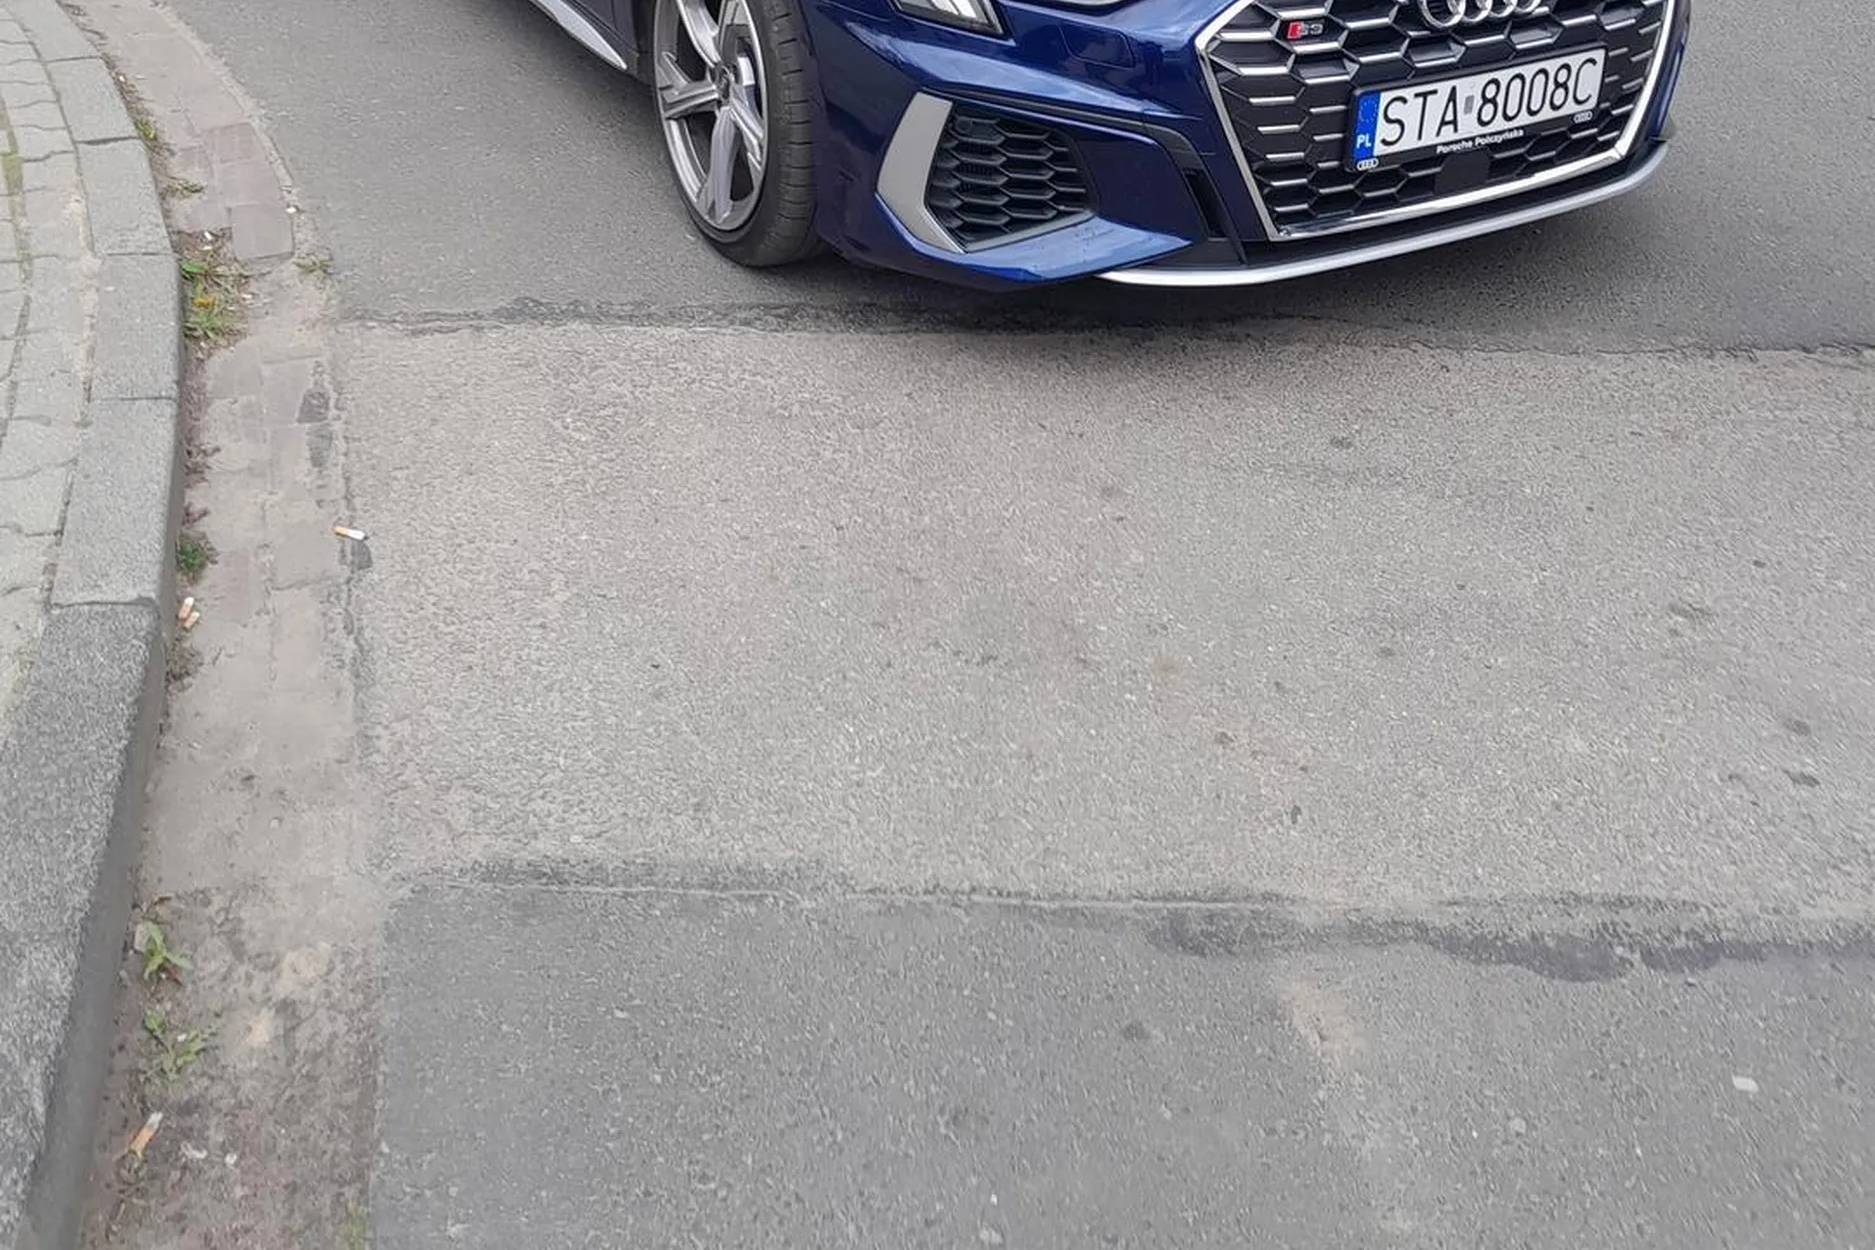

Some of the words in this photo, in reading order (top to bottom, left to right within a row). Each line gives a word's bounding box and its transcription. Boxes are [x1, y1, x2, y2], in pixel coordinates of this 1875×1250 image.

[1379, 84, 1460, 148] STA
[1476, 57, 1598, 127] 8008C
[1356, 134, 1373, 149] PL
[1436, 139, 1474, 155] Porsche
